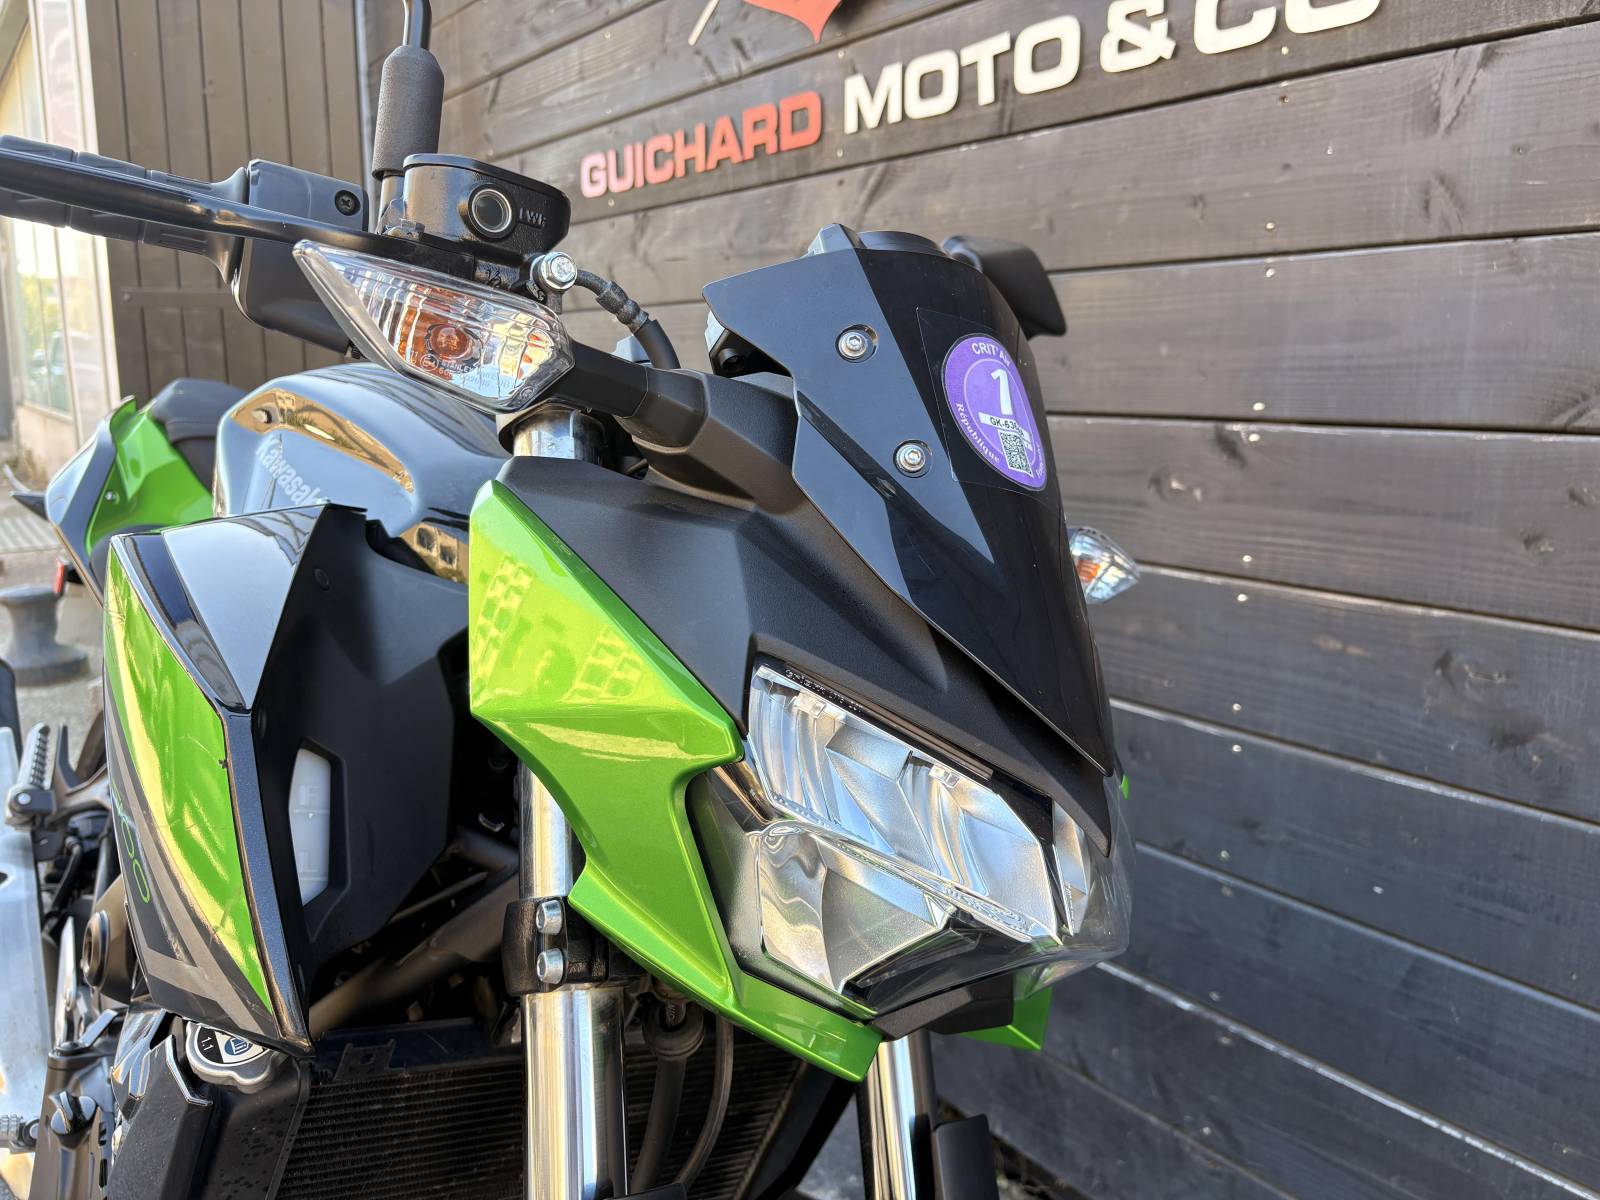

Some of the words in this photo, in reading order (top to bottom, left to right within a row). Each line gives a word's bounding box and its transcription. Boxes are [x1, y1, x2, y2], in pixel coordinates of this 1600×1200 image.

[579, 90, 823, 198] GUICHARD
[843, 15, 1082, 135] MOTO
[1100, 0, 1176, 73] &
[991, 368, 1014, 416] 1
[256, 433, 324, 506] Kawasak
[201, 1036, 215, 1051] 1.1
